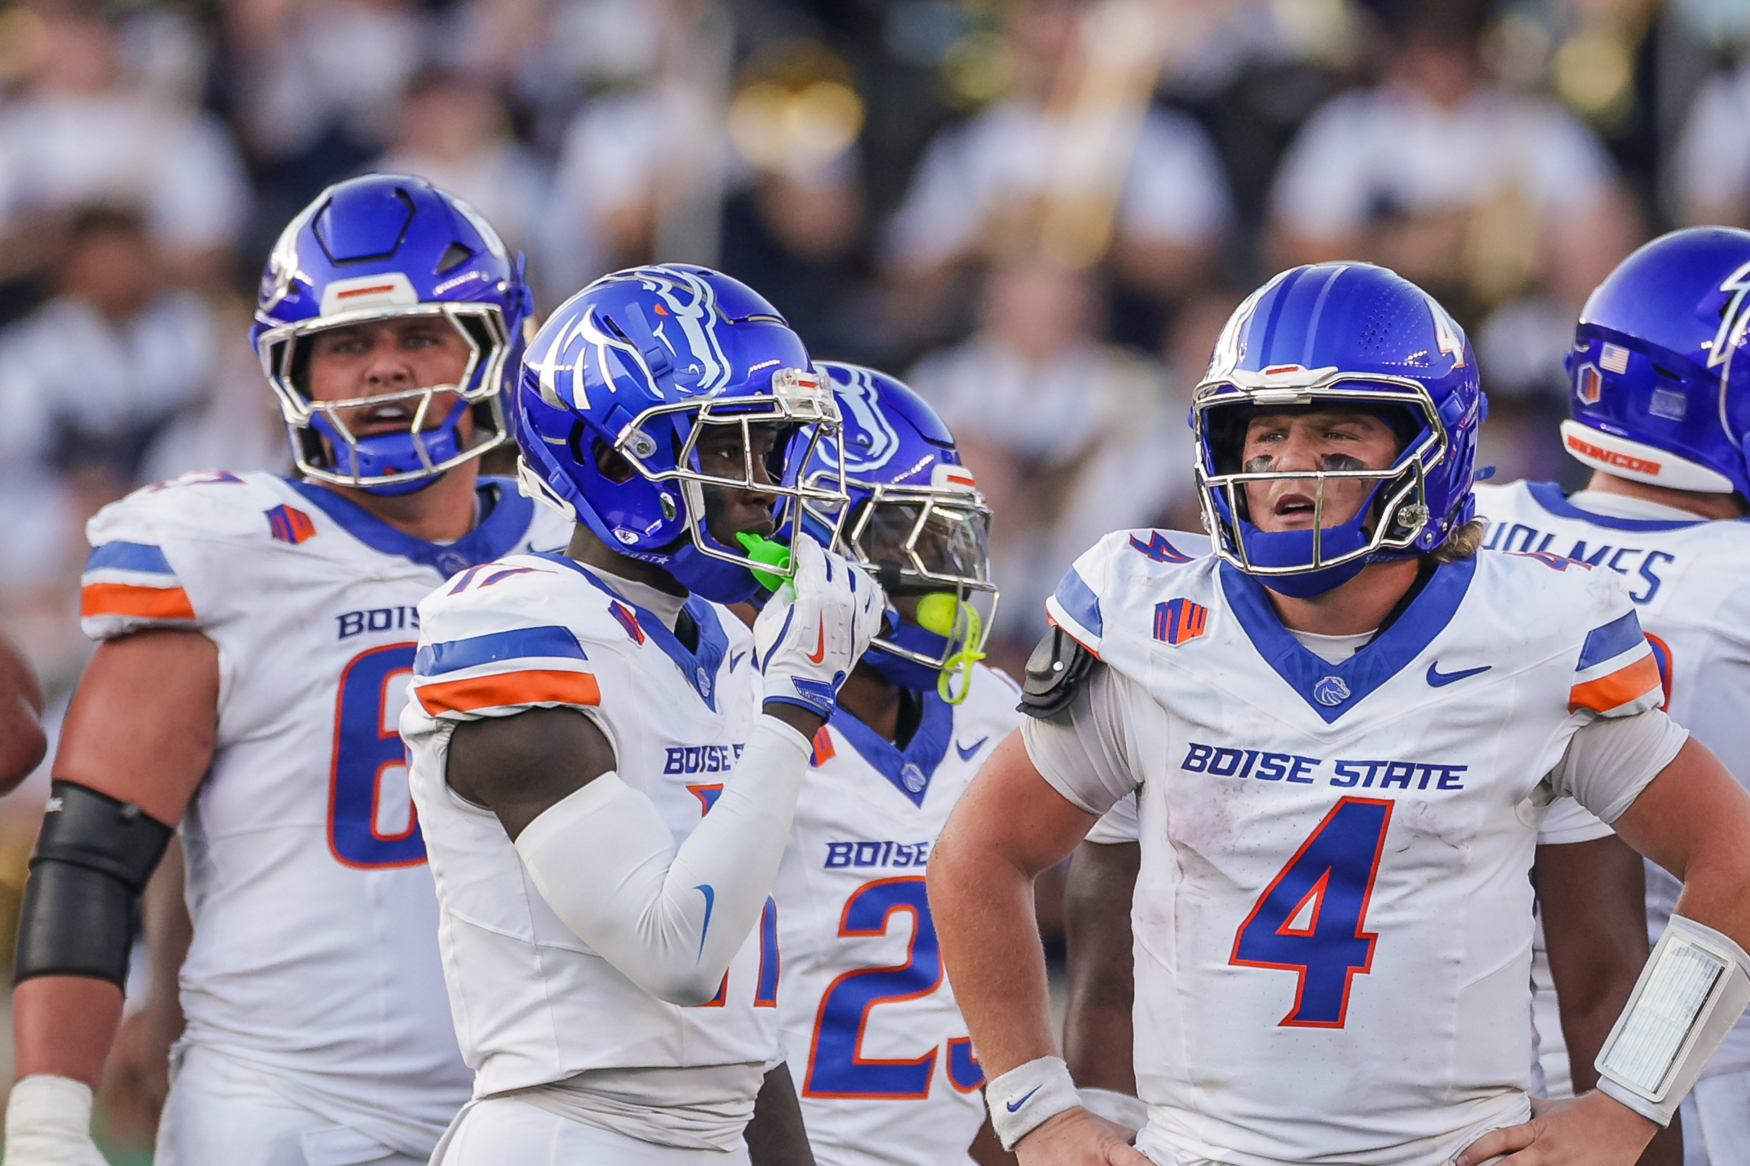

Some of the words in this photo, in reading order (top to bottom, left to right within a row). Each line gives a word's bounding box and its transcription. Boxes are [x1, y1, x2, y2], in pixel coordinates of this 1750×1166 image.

[663, 745, 731, 774] BOISE
[1180, 743, 1322, 784] BOISE
[1329, 760, 1468, 790] STATE
[824, 841, 929, 868] BOISE
[1228, 796, 1395, 1029] 4
